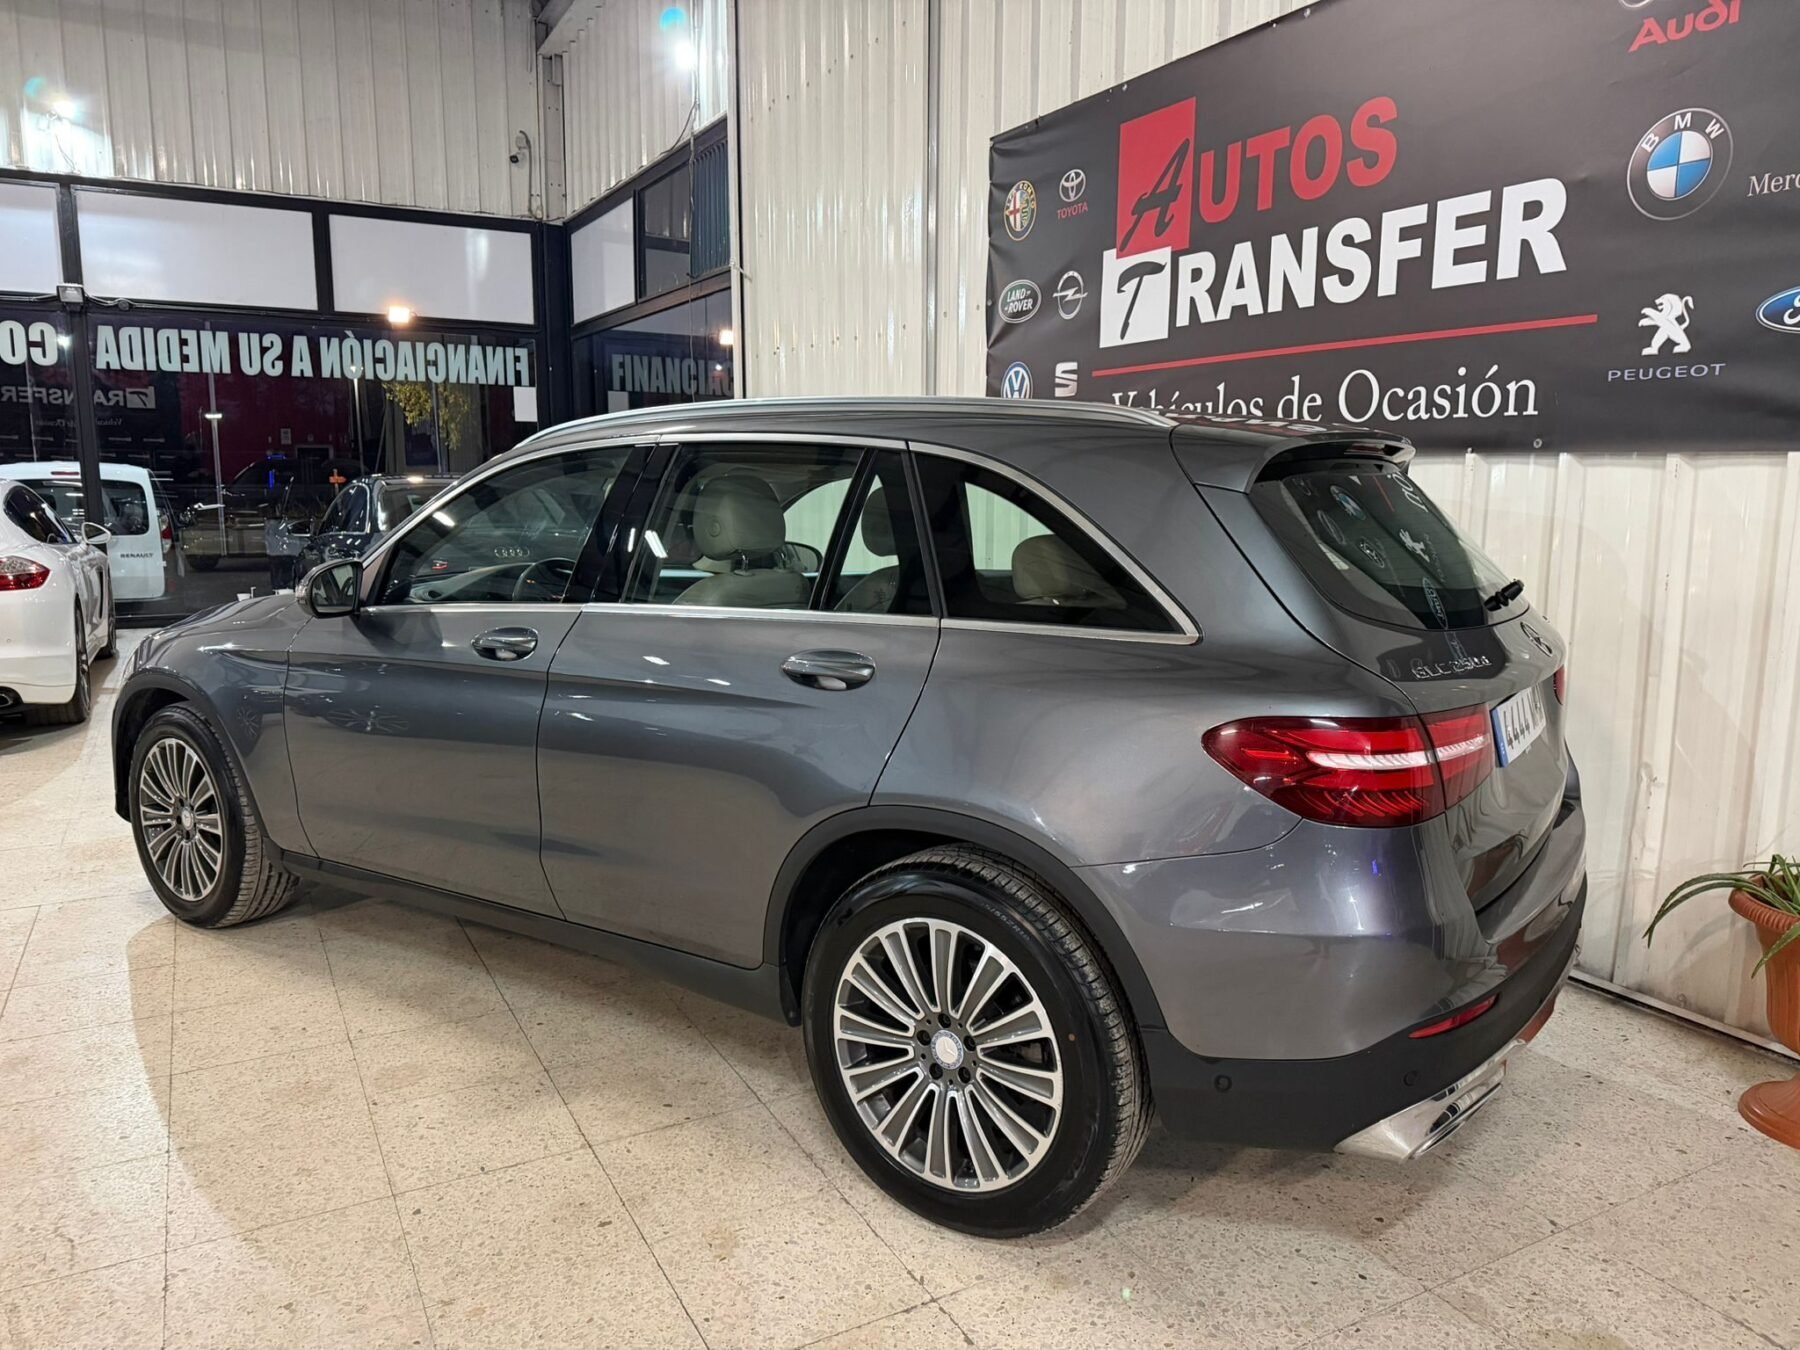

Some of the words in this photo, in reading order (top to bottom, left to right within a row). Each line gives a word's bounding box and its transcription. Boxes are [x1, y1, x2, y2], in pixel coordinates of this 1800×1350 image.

[1628, 0, 1744, 52] Audi
[1641, 112, 1724, 152] BMW
[1118, 96, 1398, 258] AUTOS
[1057, 202, 1088, 219] TOYOTA
[1100, 178, 1567, 348] TRANSFER
[1007, 288, 1026, 301] LAND
[1008, 299, 1033, 313] ROVER
[1608, 363, 1726, 382] PEUGEOT
[1112, 382, 1264, 417] hílos
[1276, 375, 1322, 422] de
[1338, 364, 1538, 423] Ocasión
